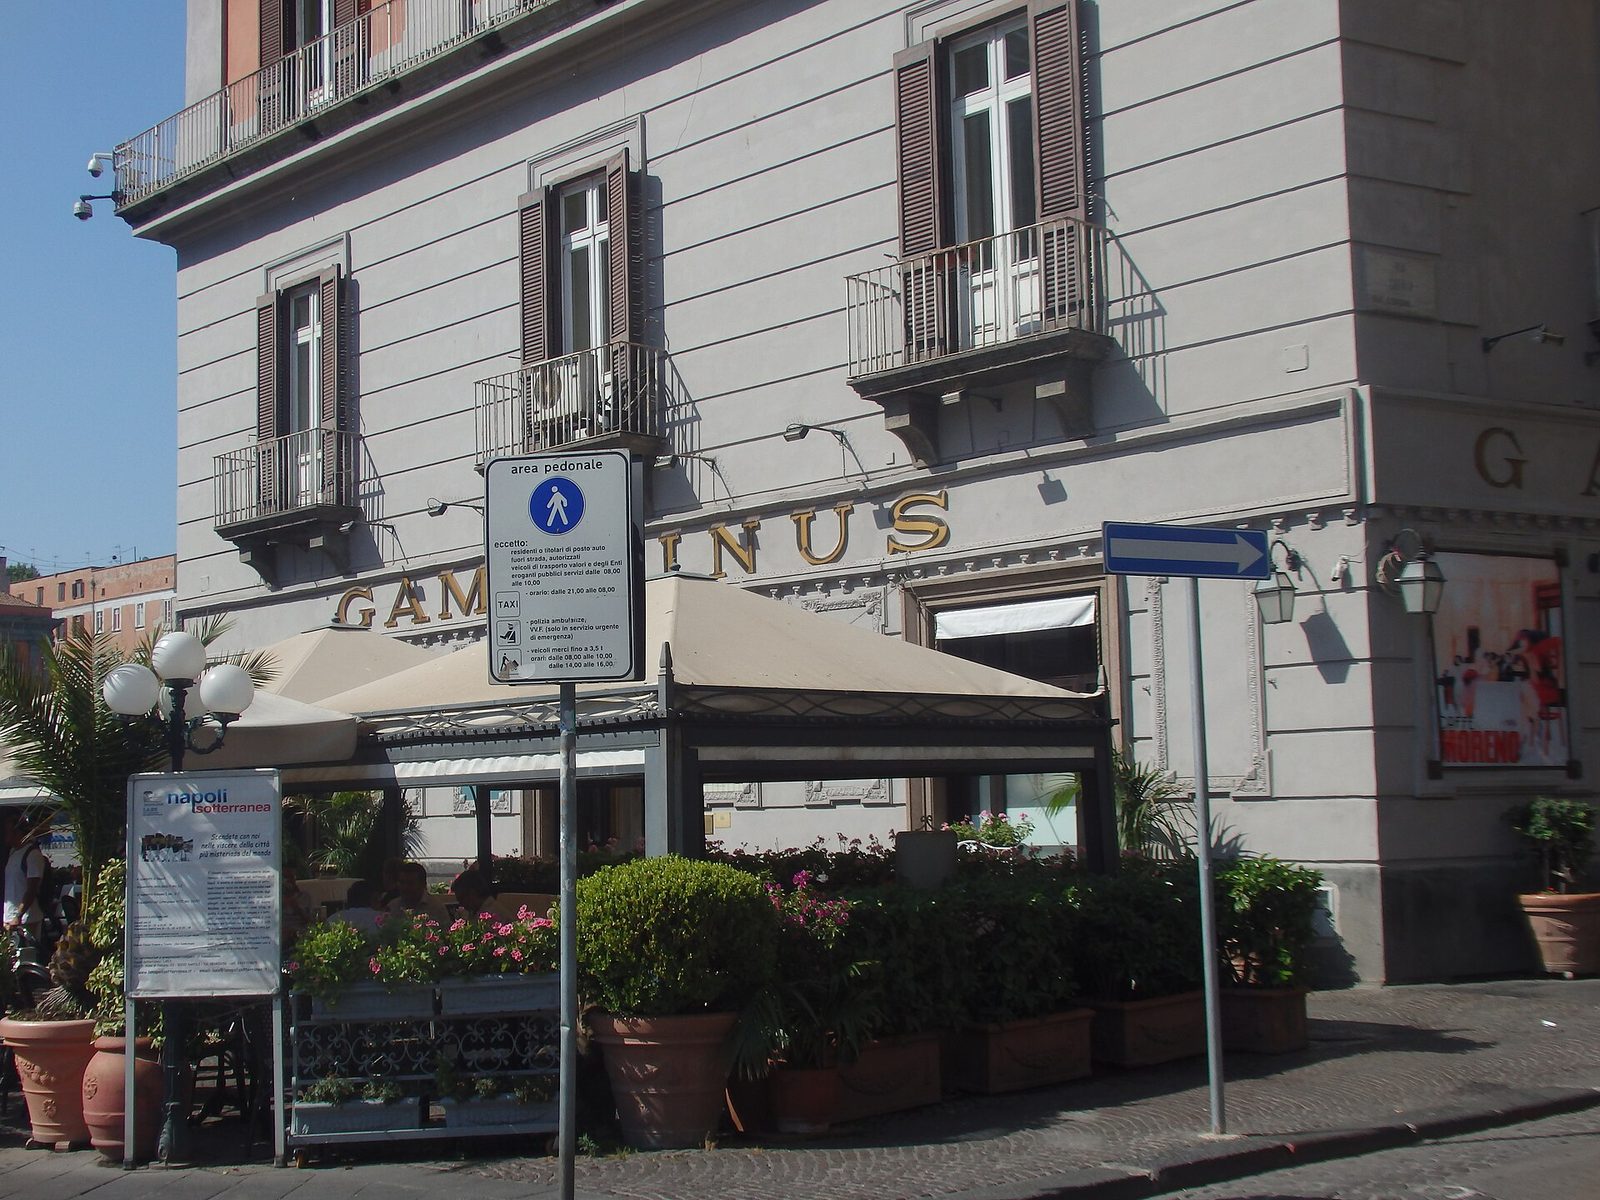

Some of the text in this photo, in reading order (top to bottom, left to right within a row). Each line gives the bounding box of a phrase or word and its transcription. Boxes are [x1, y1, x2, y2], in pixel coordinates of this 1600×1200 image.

[511, 459, 603, 474] area pedonale
[494, 540, 528, 548] eccetto:
[511, 547, 537, 555] residenti
[337, 490, 949, 628] GAMINUS
[539, 562, 568, 570] trasporto
[593, 560, 609, 568] degli
[537, 570, 563, 578] pubblici
[497, 600, 519, 608] TAXI
[530, 618, 550, 626] polizia
[537, 633, 574, 641] emergenza)
[548, 653, 564, 661] dalle
[167, 789, 228, 813] napoli
[197, 803, 271, 814] sotterranea
[241, 849, 251, 857] del
